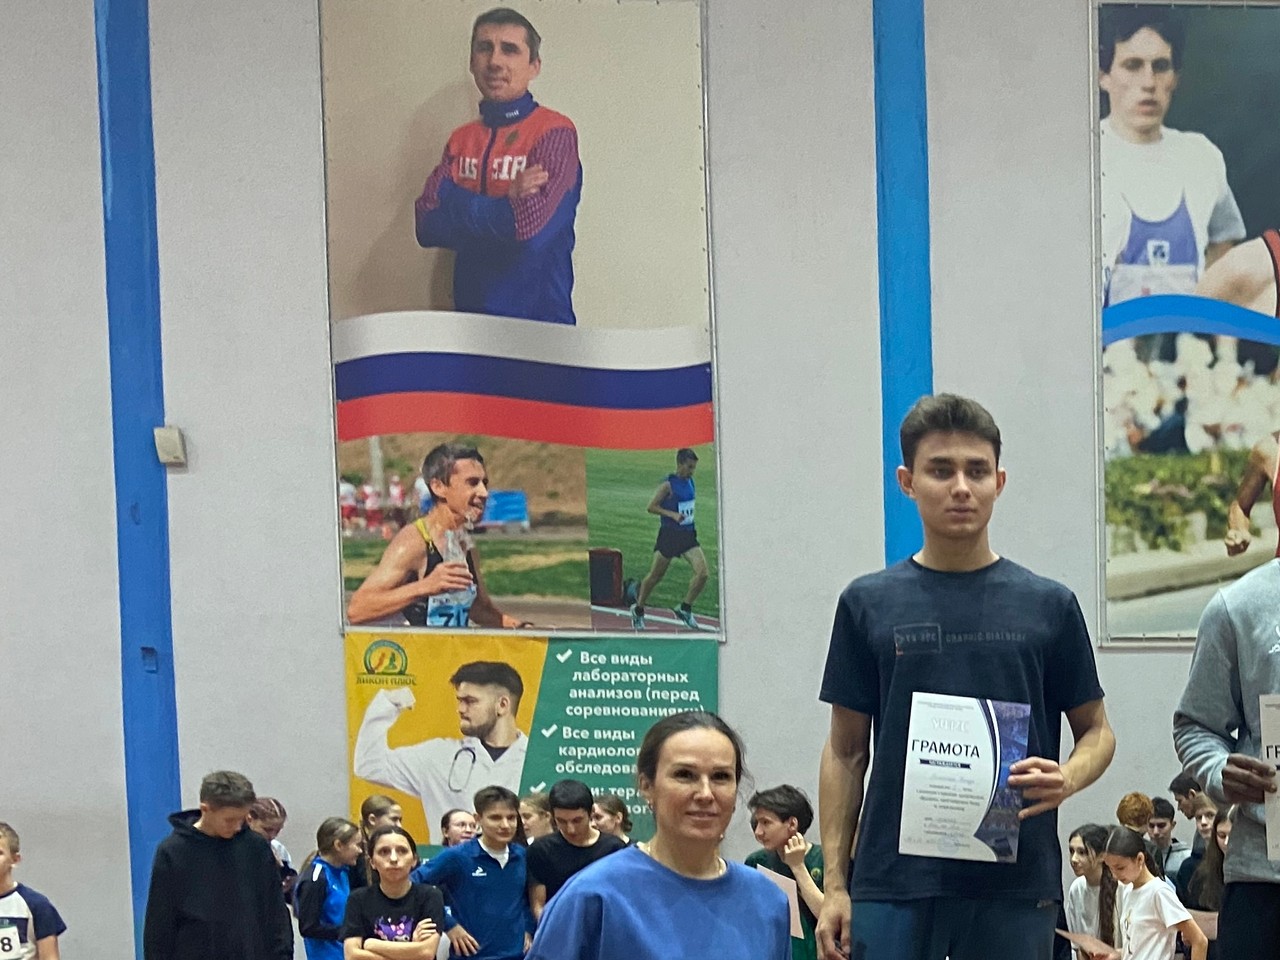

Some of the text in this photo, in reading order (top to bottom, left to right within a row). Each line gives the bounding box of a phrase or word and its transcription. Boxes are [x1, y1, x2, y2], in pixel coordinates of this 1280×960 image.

[580, 651, 652, 666] Все виды
[572, 668, 689, 685] лабораторных
[569, 687, 700, 703] анализов (перед
[562, 726, 635, 741] Все виды
[558, 746, 641, 760] кардиолог
[911, 739, 980, 758] ГРАМОТА
[555, 761, 638, 775] обследова
